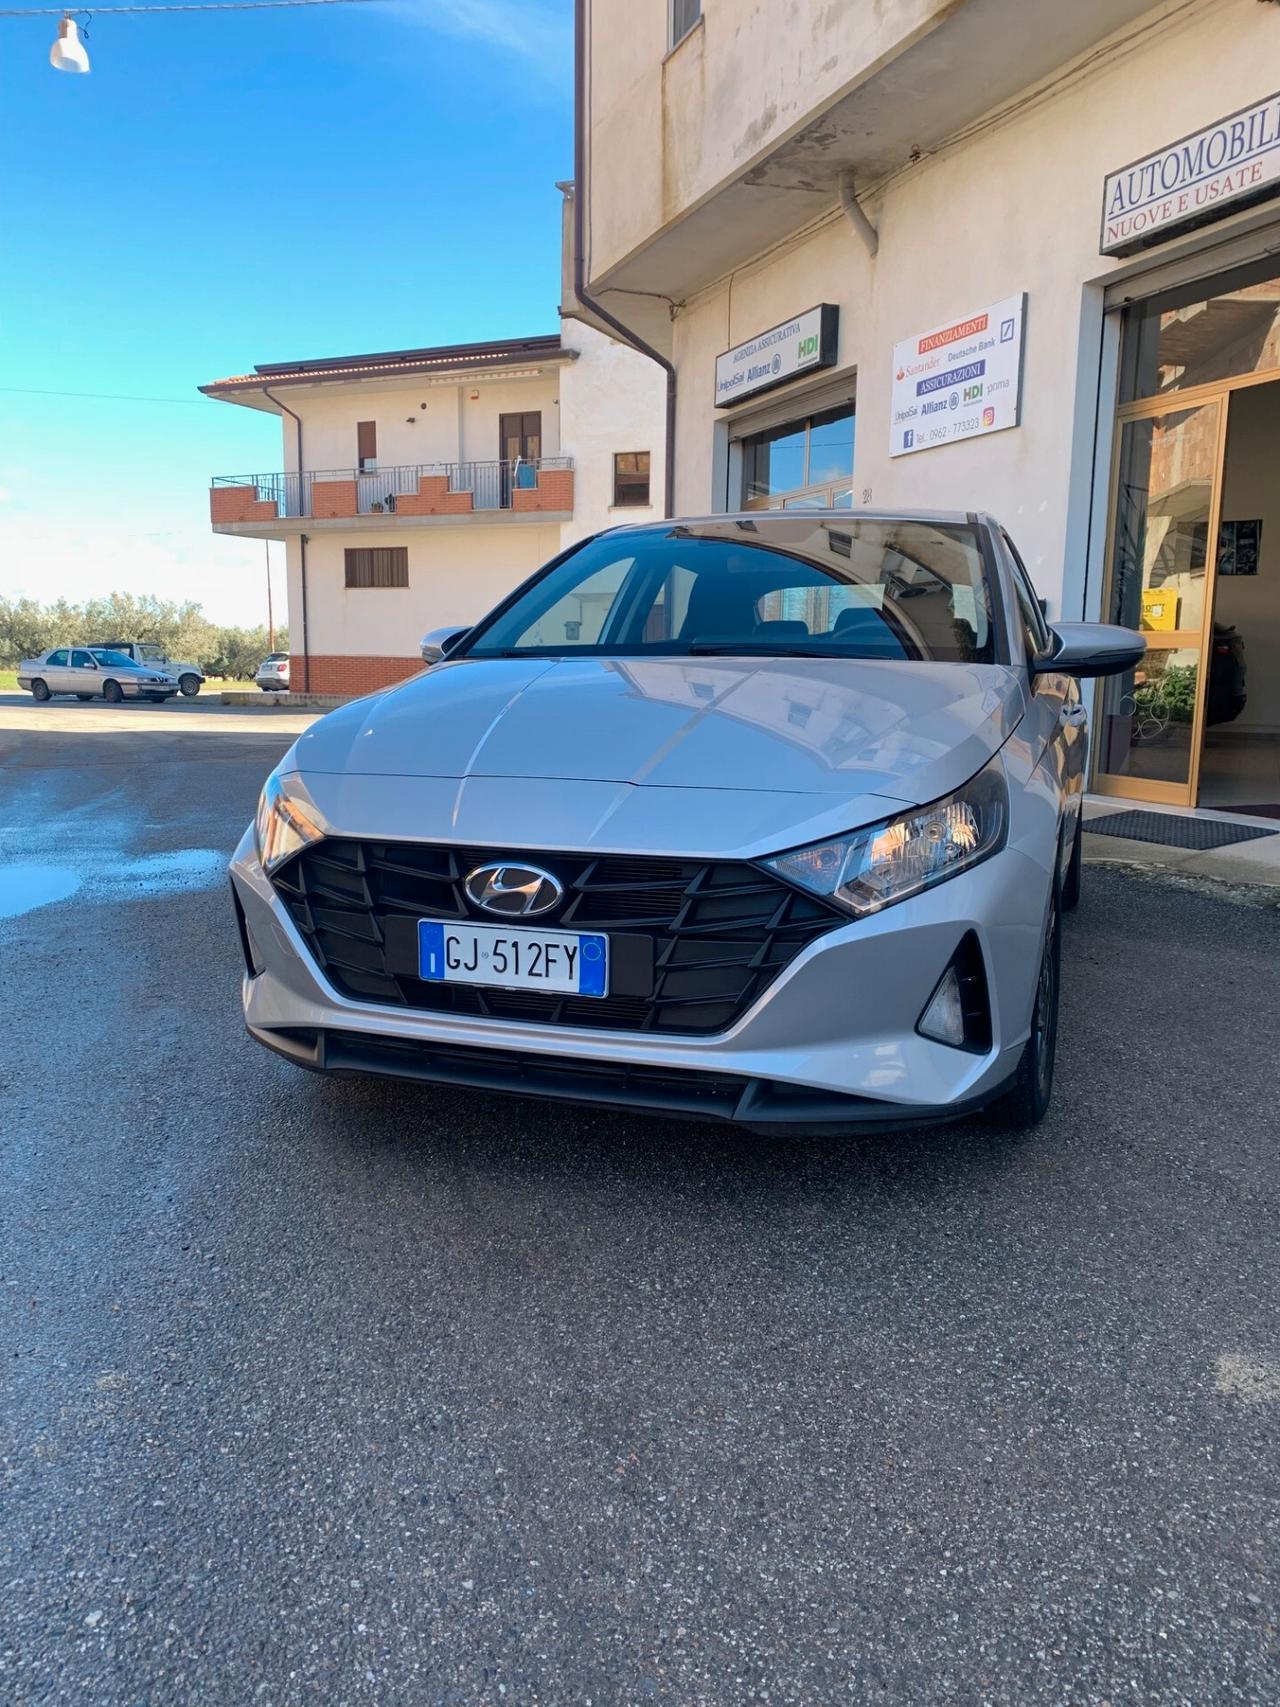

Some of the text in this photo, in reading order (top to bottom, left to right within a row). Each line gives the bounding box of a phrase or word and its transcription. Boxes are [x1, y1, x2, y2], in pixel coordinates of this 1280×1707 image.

[1107, 161, 1264, 243] NUOVE E USATE
[733, 322, 801, 362] AGENZIA ASSICURATIVA
[920, 317, 986, 352] FINANZIAMENTI
[747, 363, 771, 383] Allianz
[798, 334, 819, 359] HDI
[905, 337, 996, 377] Santander Deutsche Bank
[920, 363, 981, 393] ASSICURAZIONI
[921, 399, 948, 416] Allianz
[963, 384, 984, 401] HDI
[987, 379, 1010, 396] prima
[930, 426, 946, 440] 0962
[953, 417, 980, 435] 773323
[446, 936, 478, 971] GJ
[492, 939, 578, 980] 512FY
